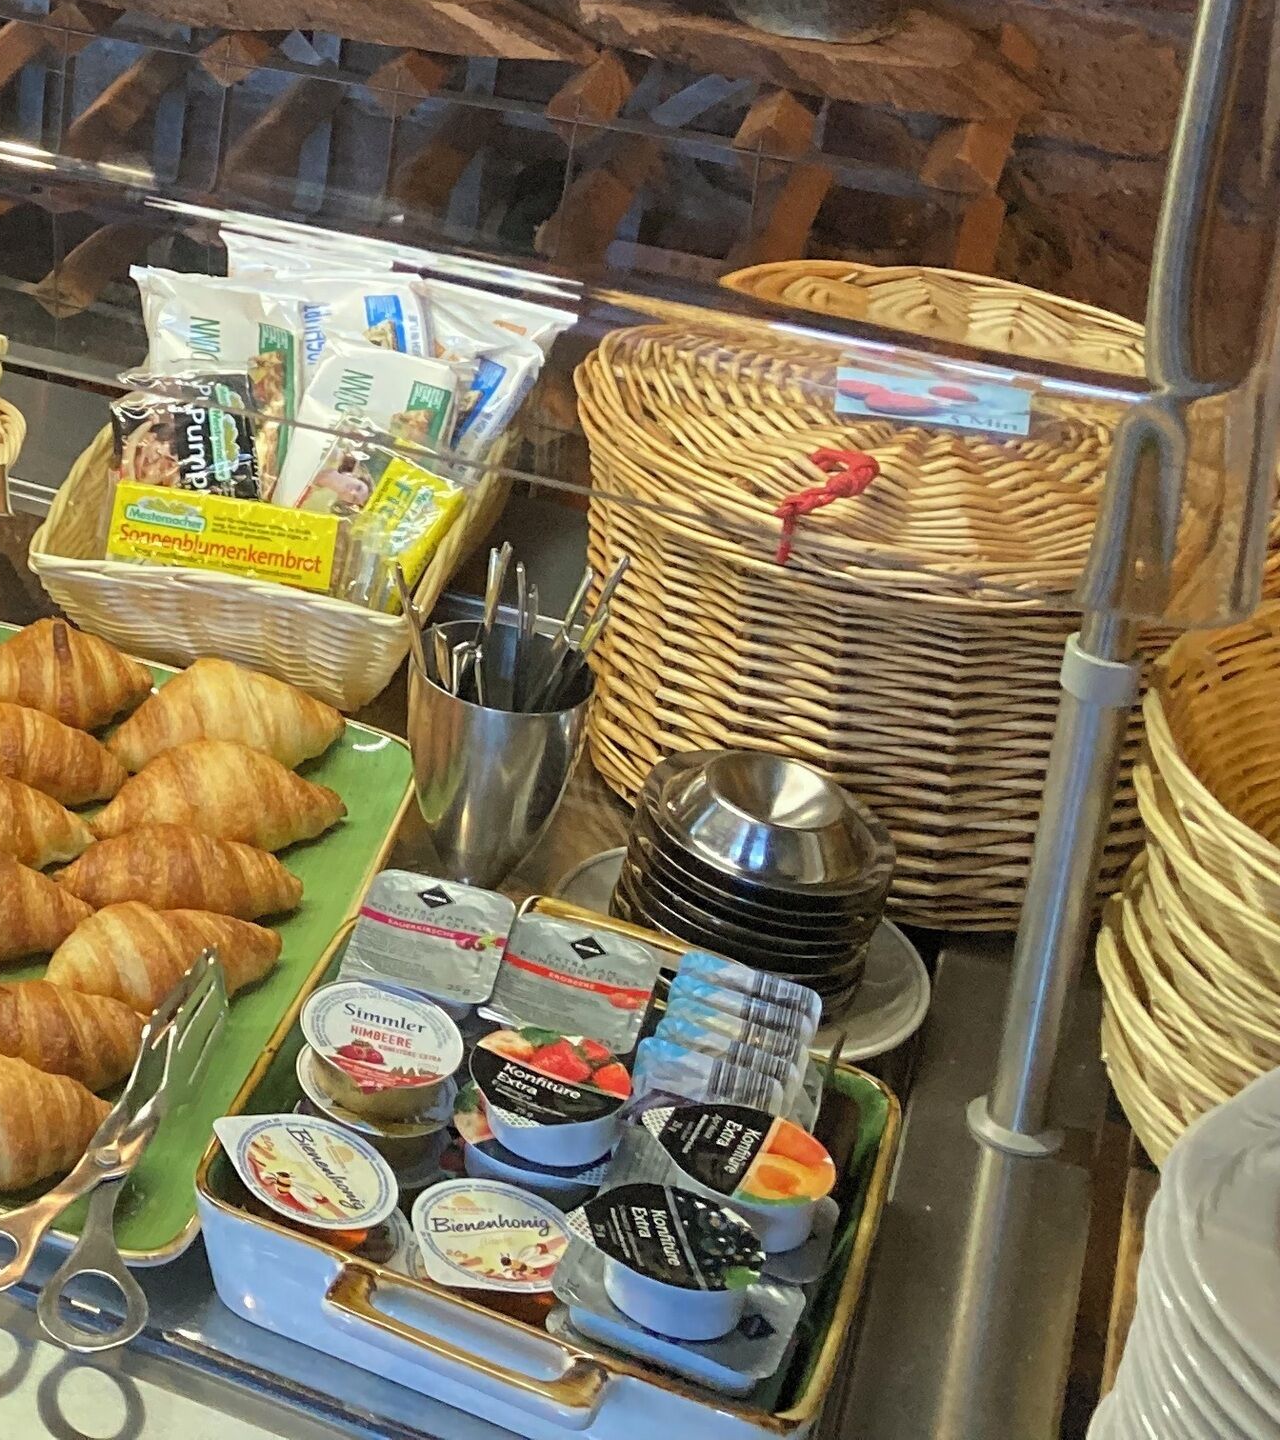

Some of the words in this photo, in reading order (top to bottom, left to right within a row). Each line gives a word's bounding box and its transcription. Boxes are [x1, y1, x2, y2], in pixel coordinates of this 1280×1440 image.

[129, 506, 204, 530] Mestemacher
[119, 524, 323, 574] Sonnenblumenkernbrot
[343, 1002, 428, 1034] Simmler
[350, 1025, 414, 1049] HIMBEERE
[496, 1071, 538, 1096] Extra
[502, 1062, 581, 1100] Konfitüre
[716, 1119, 743, 1147] Extra
[723, 1128, 762, 1175] Konfitüre
[286, 1127, 366, 1210] Bienenhonig
[430, 1214, 550, 1237] Bienenhonig
[631, 1206, 652, 1238] Extra
[650, 1209, 681, 1267] Konfitüre
